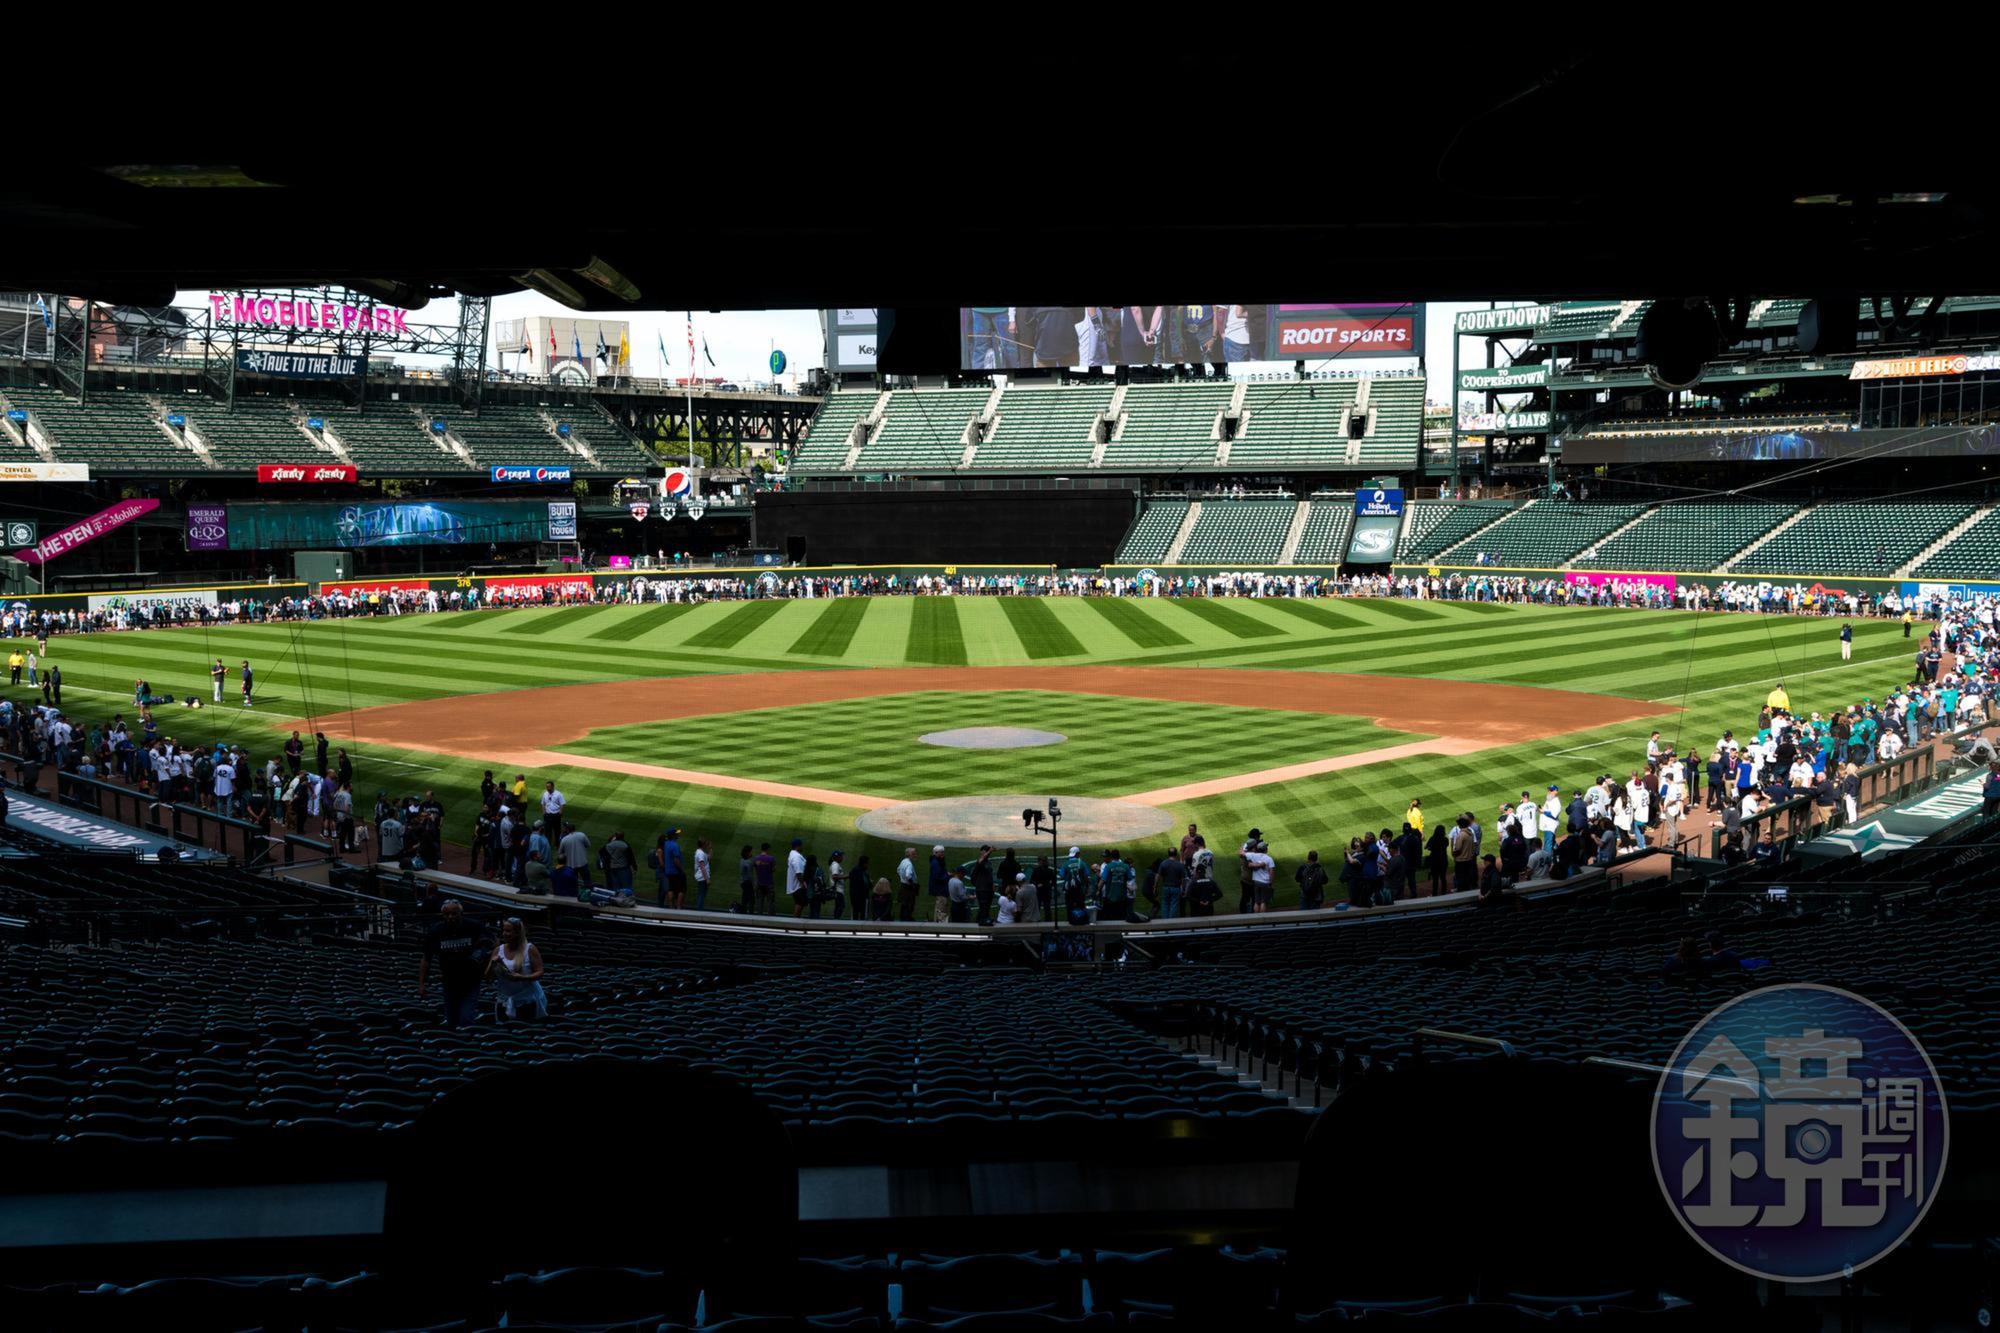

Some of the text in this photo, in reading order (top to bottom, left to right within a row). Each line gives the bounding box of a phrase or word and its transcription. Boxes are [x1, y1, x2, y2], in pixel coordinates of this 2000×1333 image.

[208, 294, 409, 334] T-MOBILE PARK
[1458, 305, 1551, 330] COUNTDOWN
[1282, 327, 1406, 345] ROOT SPORTS
[263, 351, 357, 376] TRUE TO THE BLUE
[1498, 369, 1509, 377] TO
[1461, 370, 1546, 388] COOPERSTOWN
[1519, 412, 1551, 428] DAYS
[272, 467, 305, 480] xfinity
[314, 467, 346, 480] xfinity
[508, 469, 531, 480] pepsi
[548, 469, 570, 480] pepsi
[551, 506, 572, 516] BUILT
[1368, 502, 1391, 510] Holland
[189, 509, 225, 517] EMERALD
[194, 516, 219, 524] QUEEN
[551, 526, 574, 535] TOUGH
[32, 537, 64, 560] THE
[944, 567, 957, 575] 401
[218, 769, 228, 778] 42
[383, 827, 393, 838] 31
